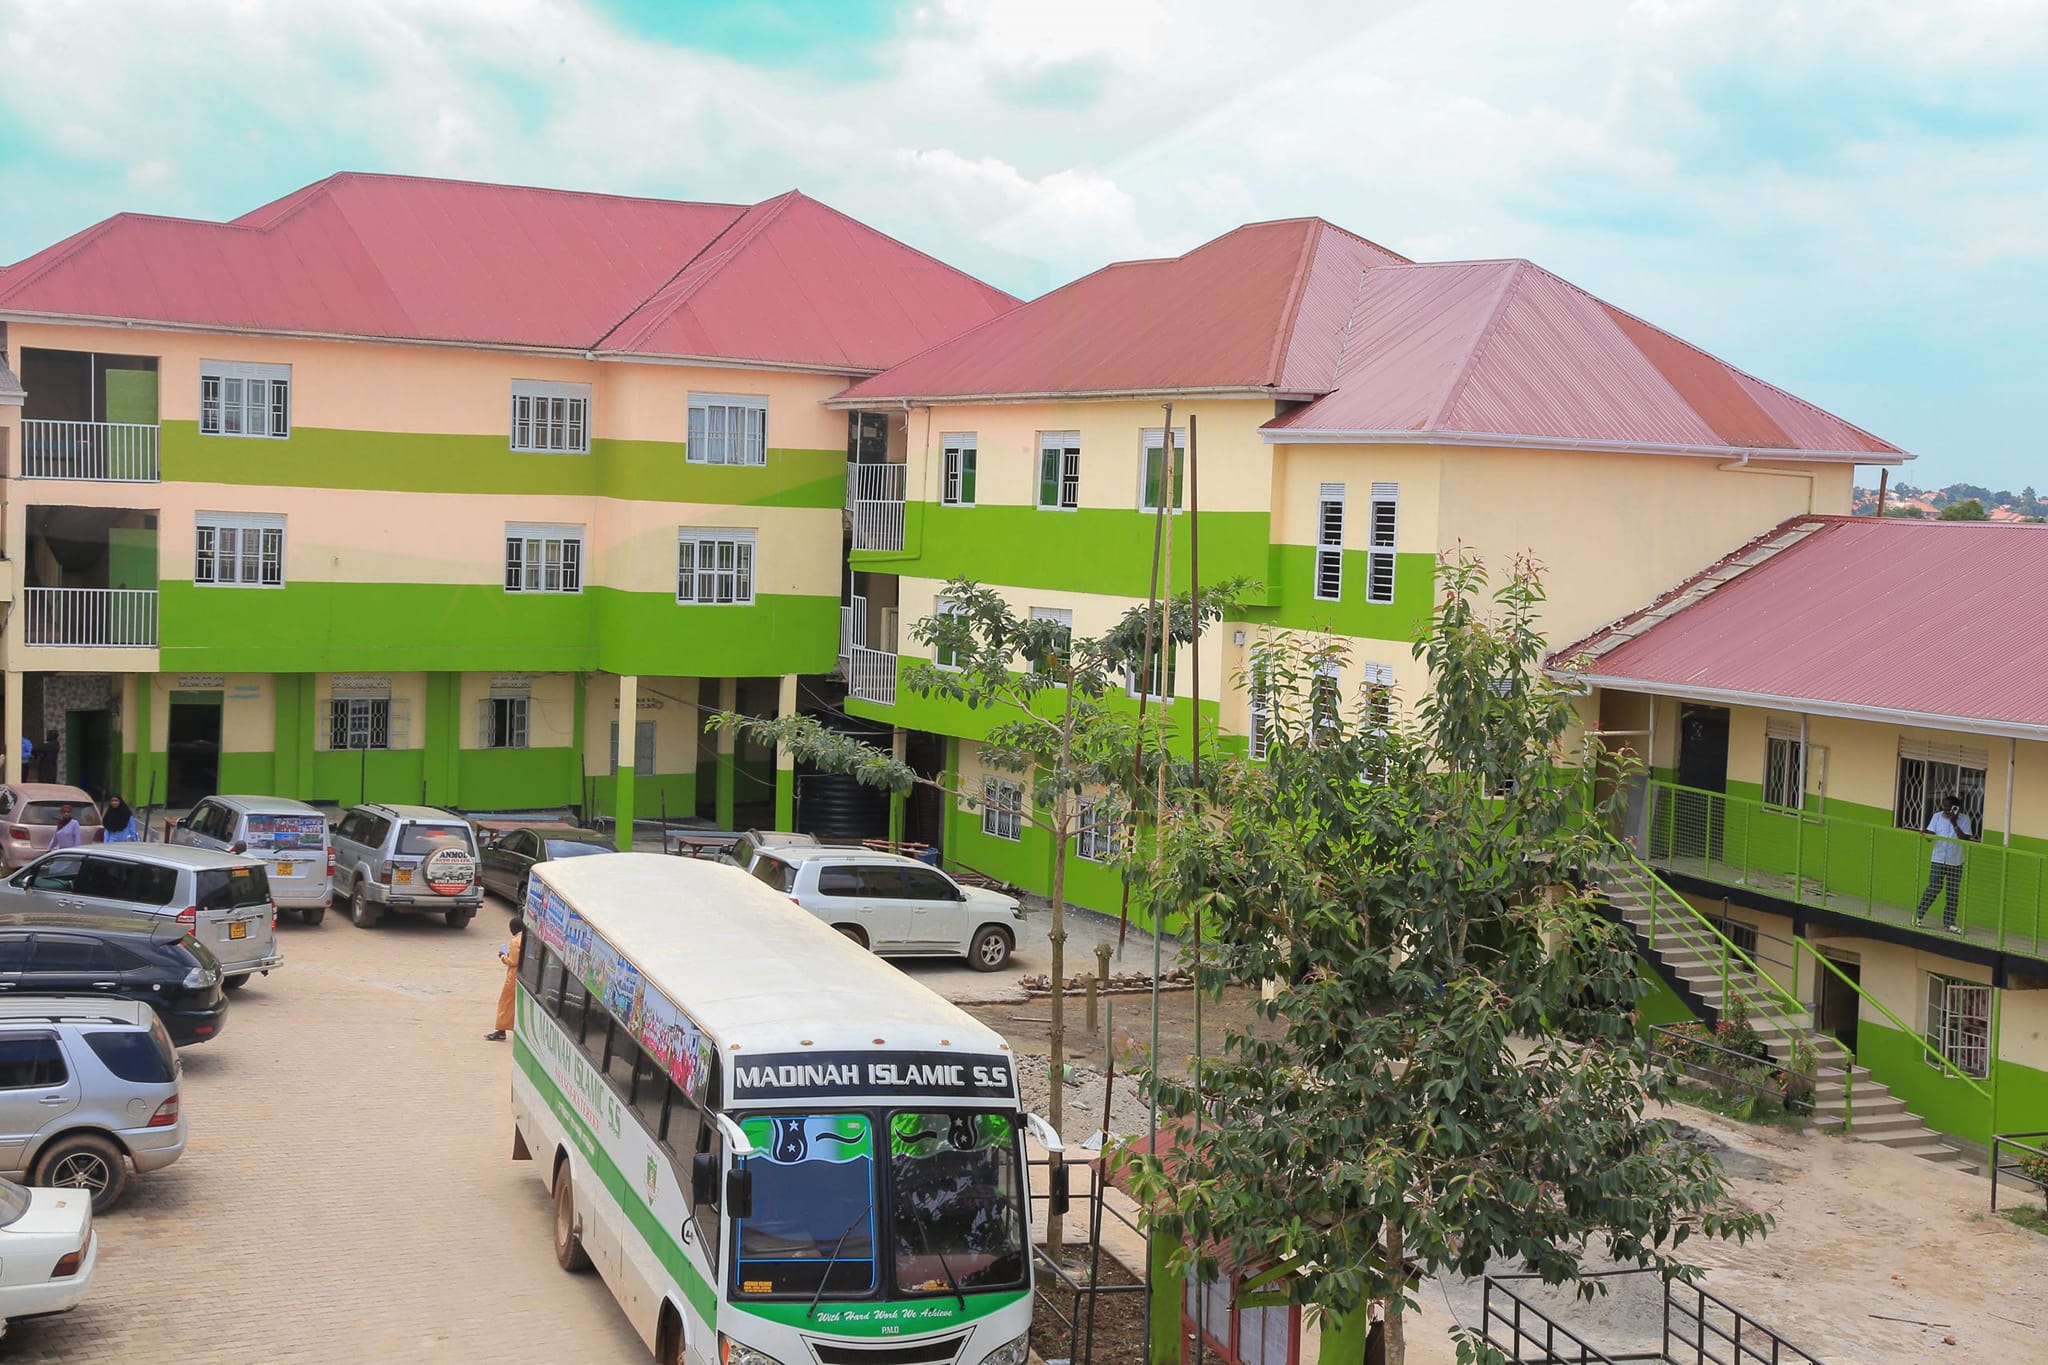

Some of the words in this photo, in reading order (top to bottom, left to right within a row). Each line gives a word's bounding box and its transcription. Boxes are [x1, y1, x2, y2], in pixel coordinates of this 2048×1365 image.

[735, 1064, 859, 1088] MADINAH
[868, 1063, 965, 1086] ISLAMIC
[973, 1066, 1008, 1087] S.S
[817, 1312, 840, 1322] With
[843, 1310, 869, 1320] Hard
[874, 1309, 898, 1320] Work
[902, 1308, 917, 1318] We
[920, 1307, 952, 1317] Achieve
